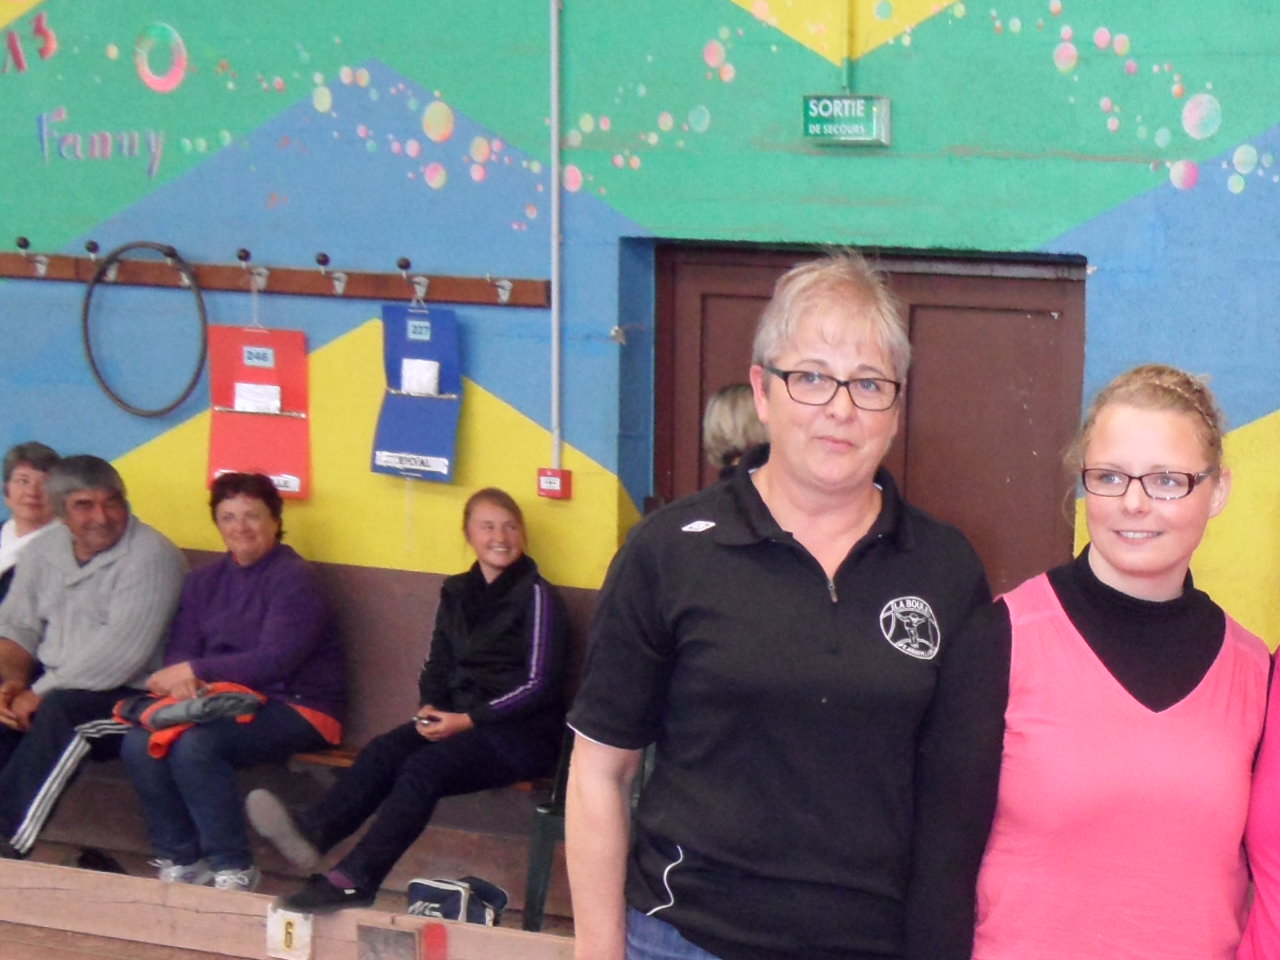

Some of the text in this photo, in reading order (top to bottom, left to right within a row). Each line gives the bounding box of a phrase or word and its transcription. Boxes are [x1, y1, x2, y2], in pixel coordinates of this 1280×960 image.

[808, 98, 865, 117] SORTIE
[808, 124, 865, 135] DE SECOURS
[36, 106, 164, 179] Fanny
